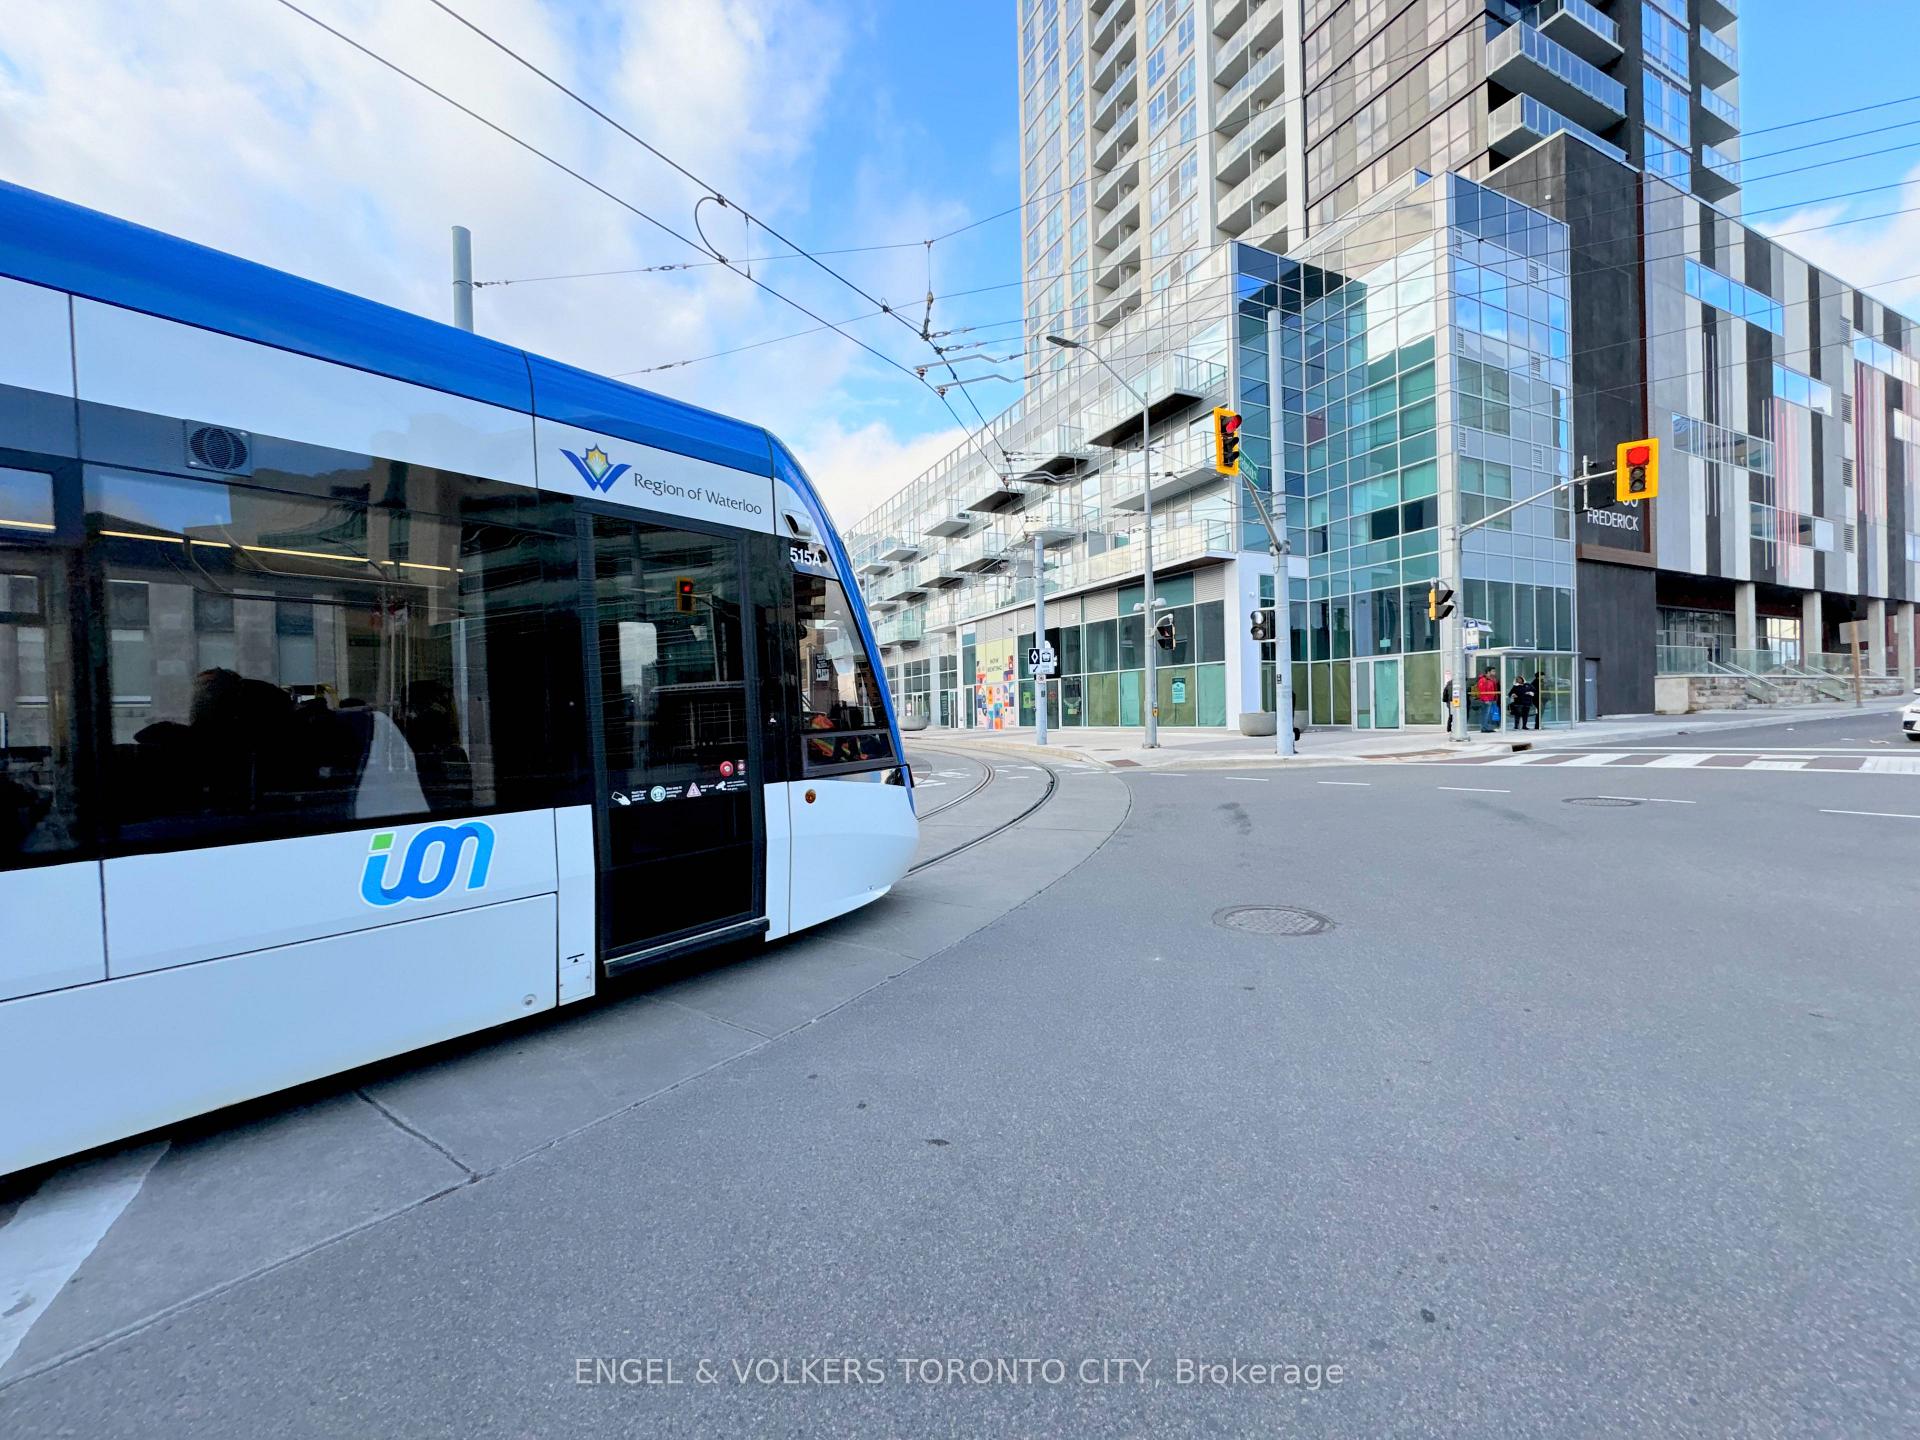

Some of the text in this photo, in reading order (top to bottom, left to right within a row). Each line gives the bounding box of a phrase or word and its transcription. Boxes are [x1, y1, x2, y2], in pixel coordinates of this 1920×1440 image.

[634, 472, 762, 515] Region of Waterloo
[1587, 508, 1639, 531] FREDERICK
[789, 546, 822, 567] 515A
[360, 820, 495, 907] ion
